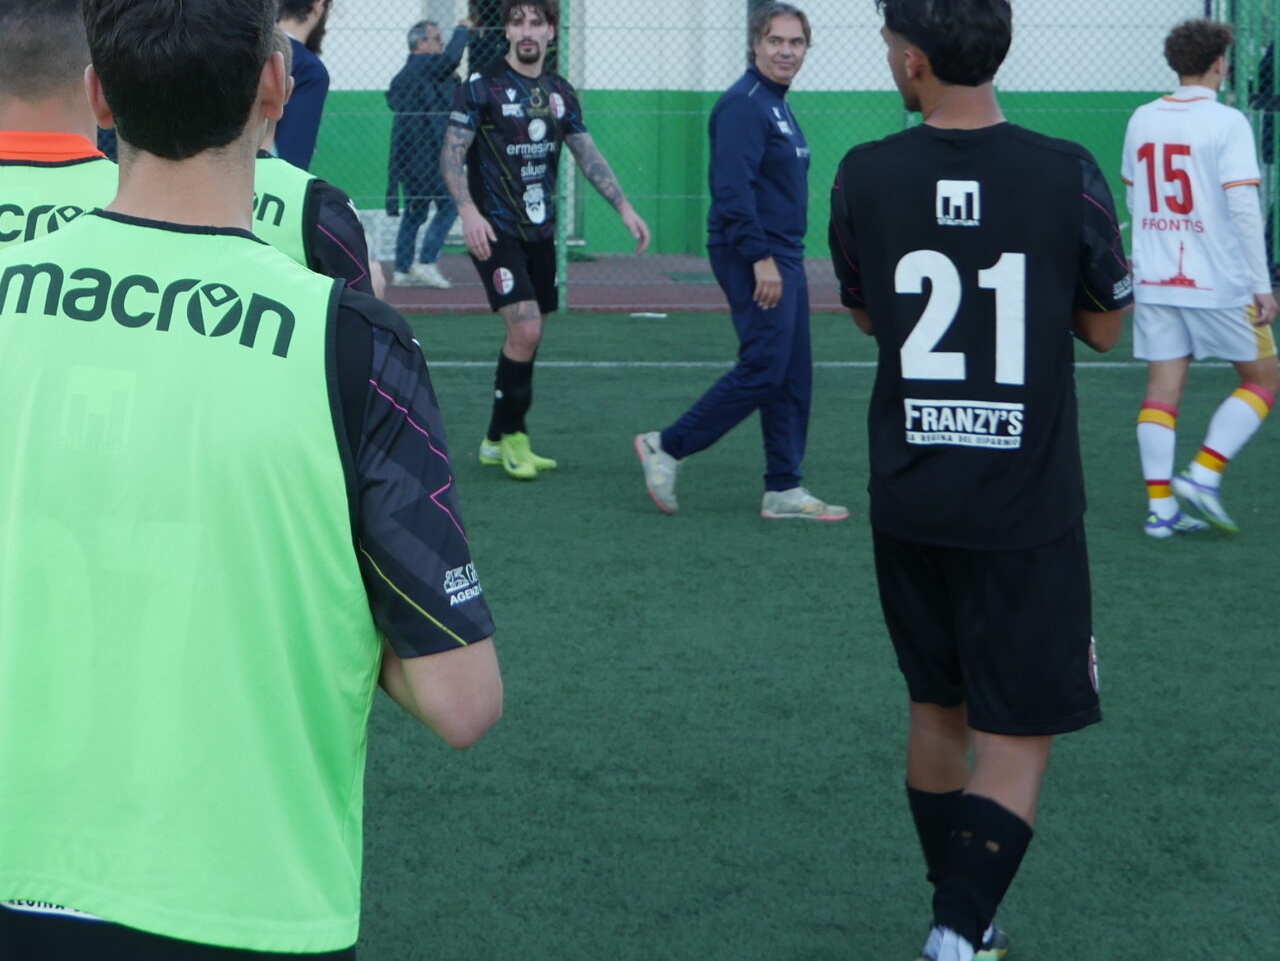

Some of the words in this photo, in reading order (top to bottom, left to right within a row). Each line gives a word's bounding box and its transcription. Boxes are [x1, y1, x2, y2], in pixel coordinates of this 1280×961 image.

[1136, 142, 1194, 215] 15
[894, 249, 1027, 386] 21
[904, 398, 1024, 436] FRANZY'S
